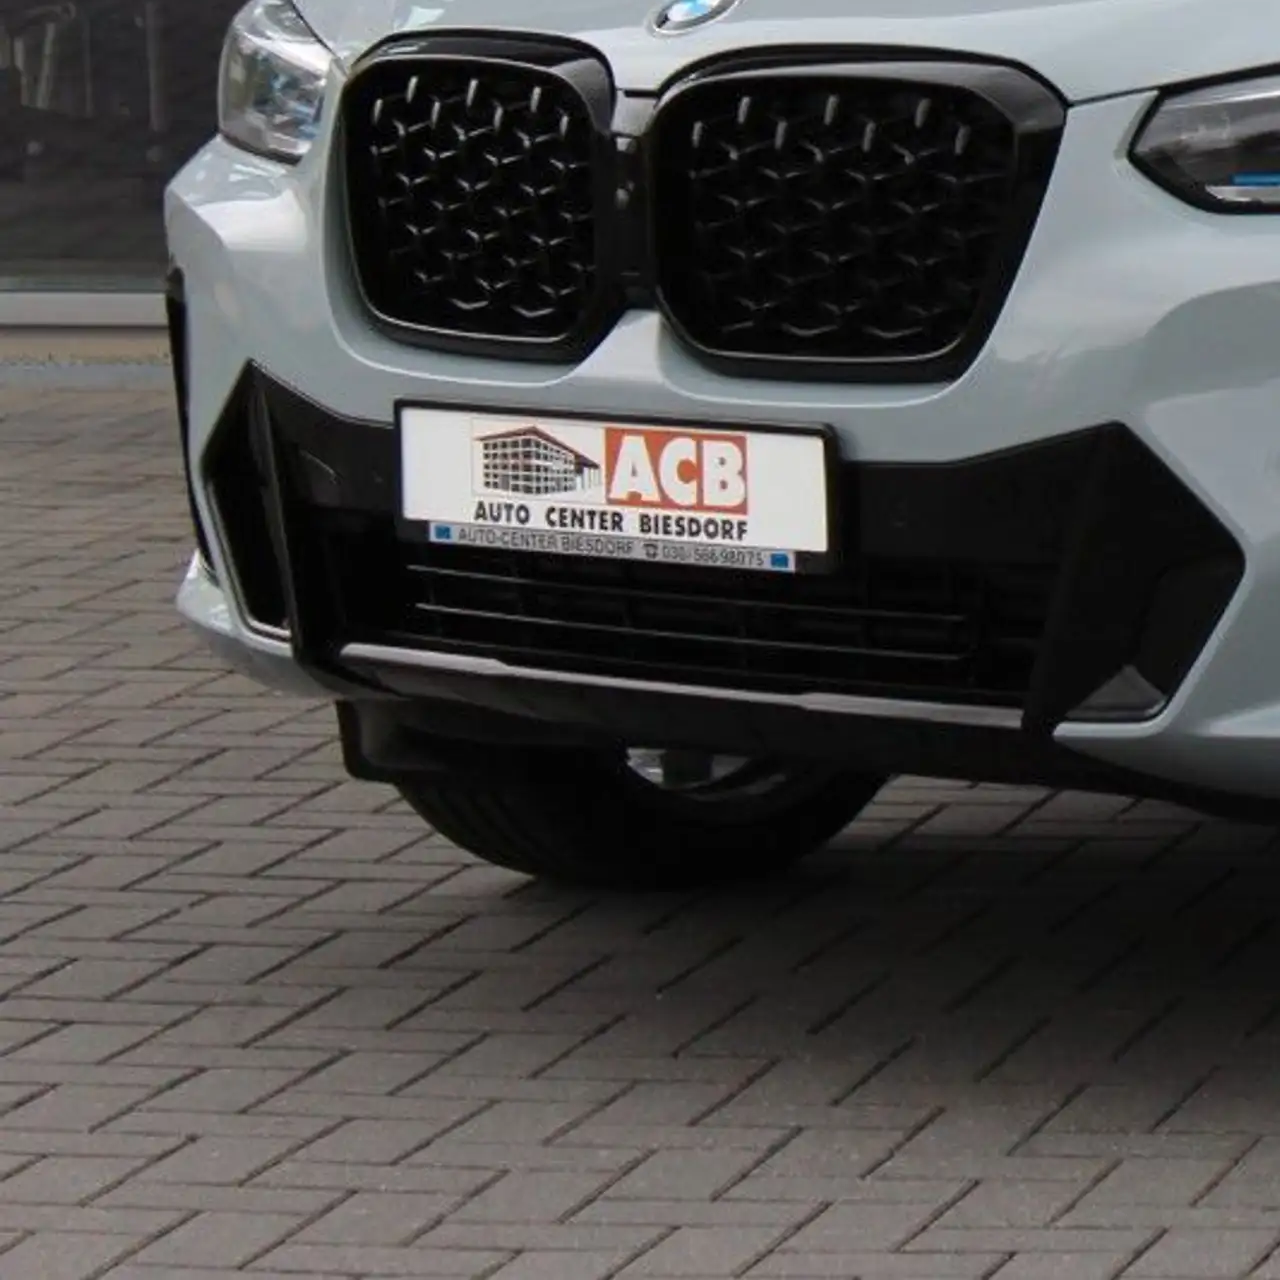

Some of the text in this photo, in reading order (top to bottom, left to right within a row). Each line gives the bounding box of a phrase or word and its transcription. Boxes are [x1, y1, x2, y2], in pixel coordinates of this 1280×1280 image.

[608, 435, 745, 507] ACB
[474, 500, 747, 540] AUTO CENTER BIESDORF
[458, 528, 557, 549] AUTO-CENTER
[561, 537, 634, 556] BIESDORF
